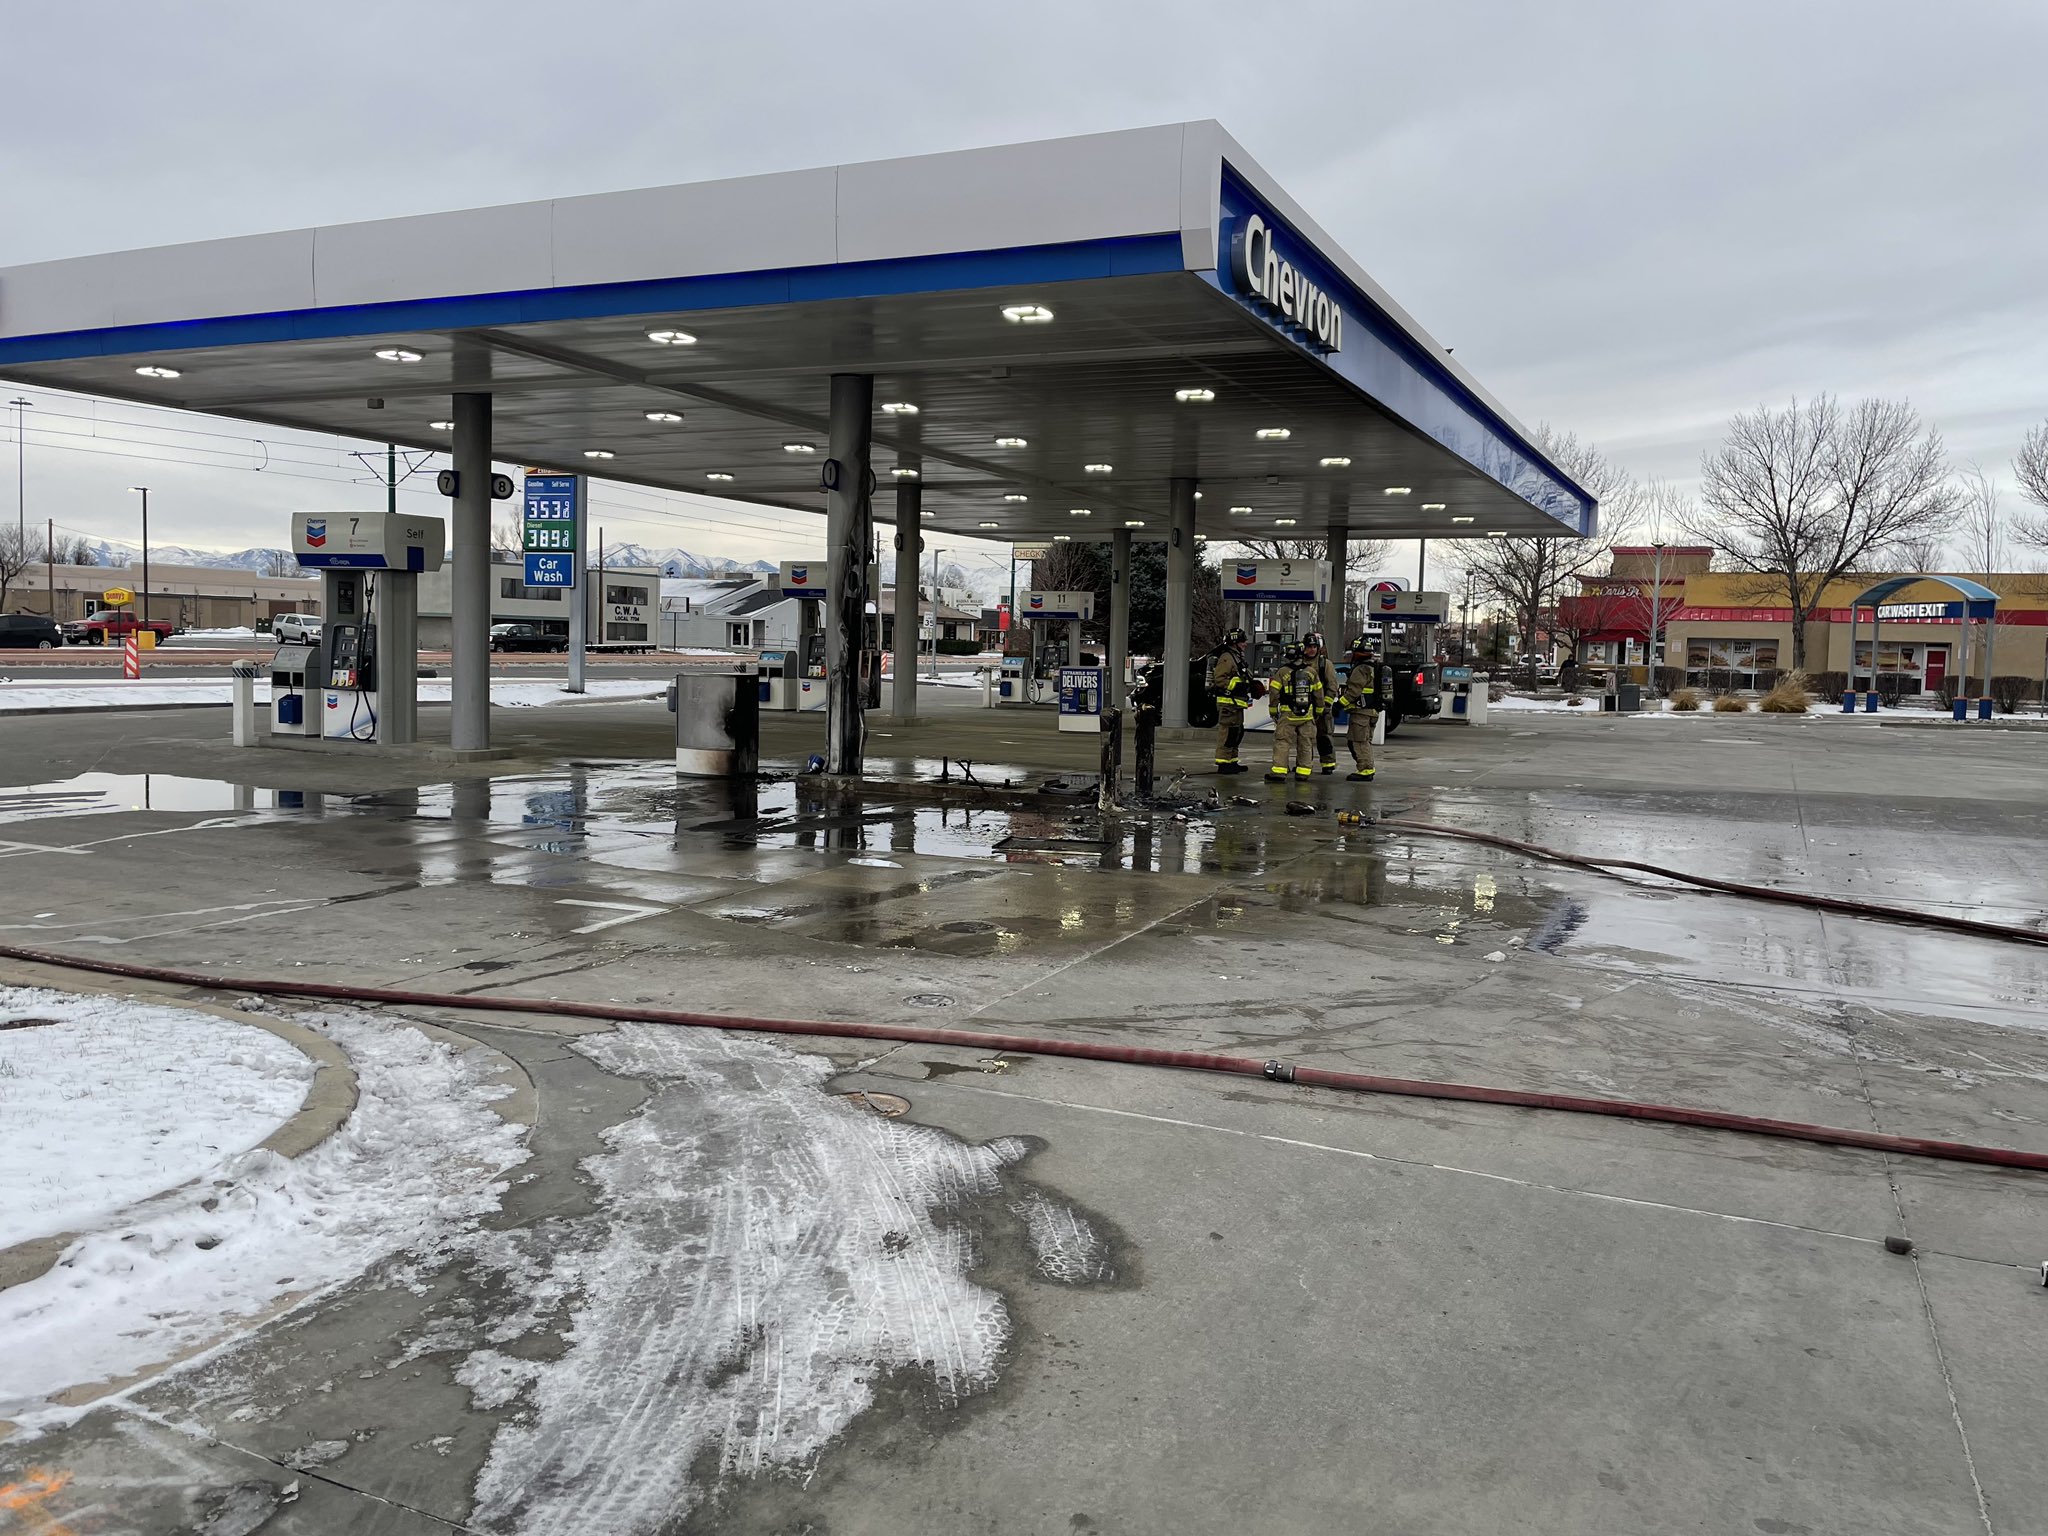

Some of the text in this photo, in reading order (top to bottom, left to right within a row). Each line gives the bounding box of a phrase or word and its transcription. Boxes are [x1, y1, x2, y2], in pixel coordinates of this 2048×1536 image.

[1245, 214, 1342, 352] Chevron
[444, 477, 450, 489] 7
[498, 481, 506, 492] 8
[527, 480, 544, 488] Gasoline
[349, 518, 359, 535] 7
[406, 529, 424, 539] Self
[539, 558, 558, 569] Car
[1281, 563, 1291, 576] 3
[534, 571, 563, 582] Wash
[1057, 594, 1066, 603] 11
[1415, 595, 1423, 604] 5
[614, 606, 640, 616] C.W.A.
[1878, 603, 1944, 618] CAR WASH EXIT
[1062, 675, 1098, 688] DELIVERS
